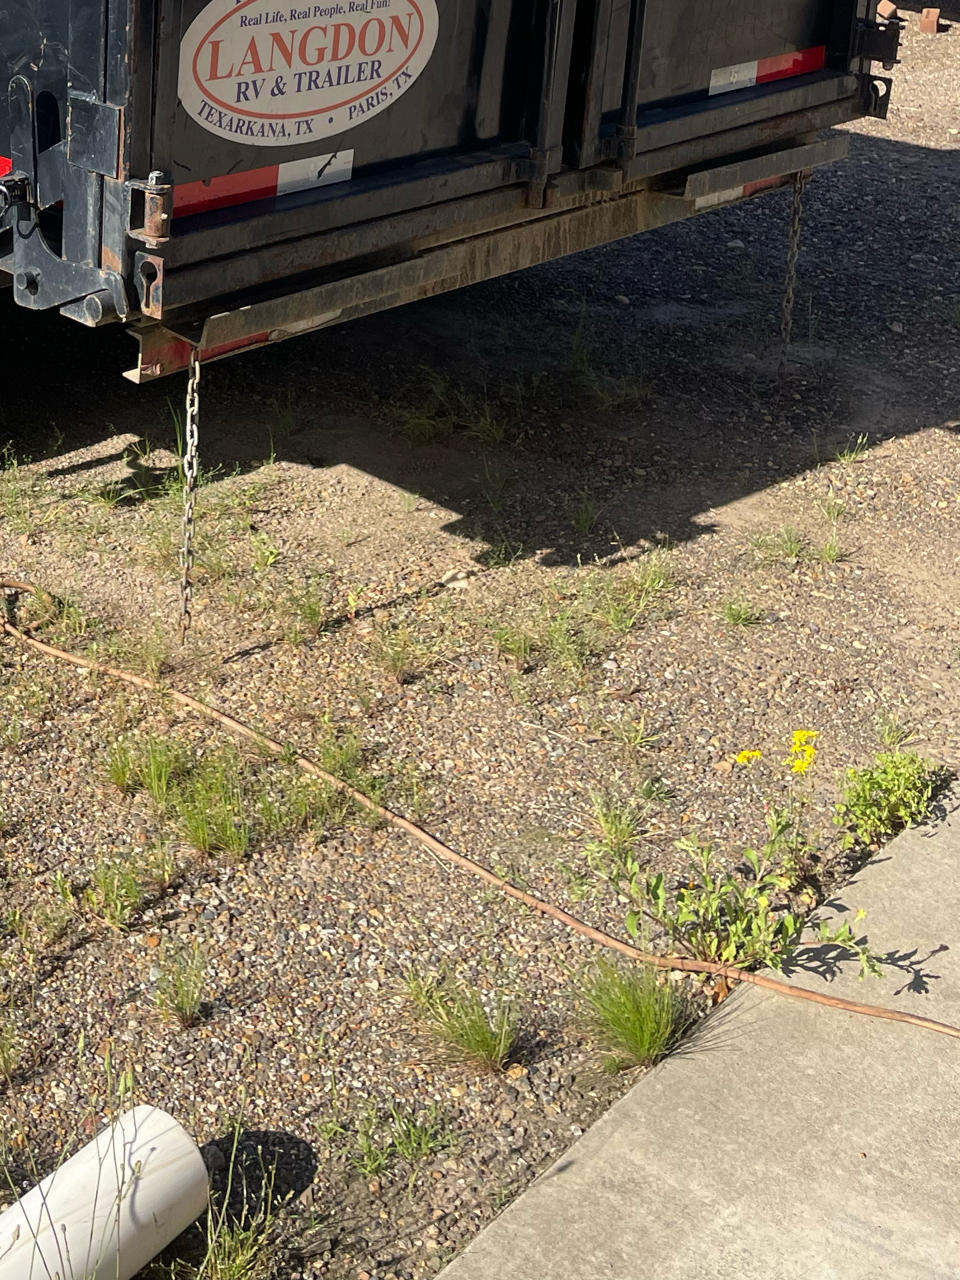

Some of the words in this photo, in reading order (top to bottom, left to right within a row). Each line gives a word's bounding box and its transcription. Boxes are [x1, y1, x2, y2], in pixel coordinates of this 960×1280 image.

[240, 13, 262, 28] Real
[265, 10, 287, 24] Life,
[289, 6, 311, 21] Real
[313, 3, 346, 19] People,
[348, 0, 369, 13] Real
[205, 12, 414, 82] LANGDON
[197, 100, 291, 140] TEXARKANA,
[295, 118, 314, 136] TX
[348, 86, 393, 122] PARIS,
[392, 67, 413, 91] TX
[235, 79, 265, 104] RV
[270, 75, 286, 98] &
[294, 59, 383, 94] TRAILER
